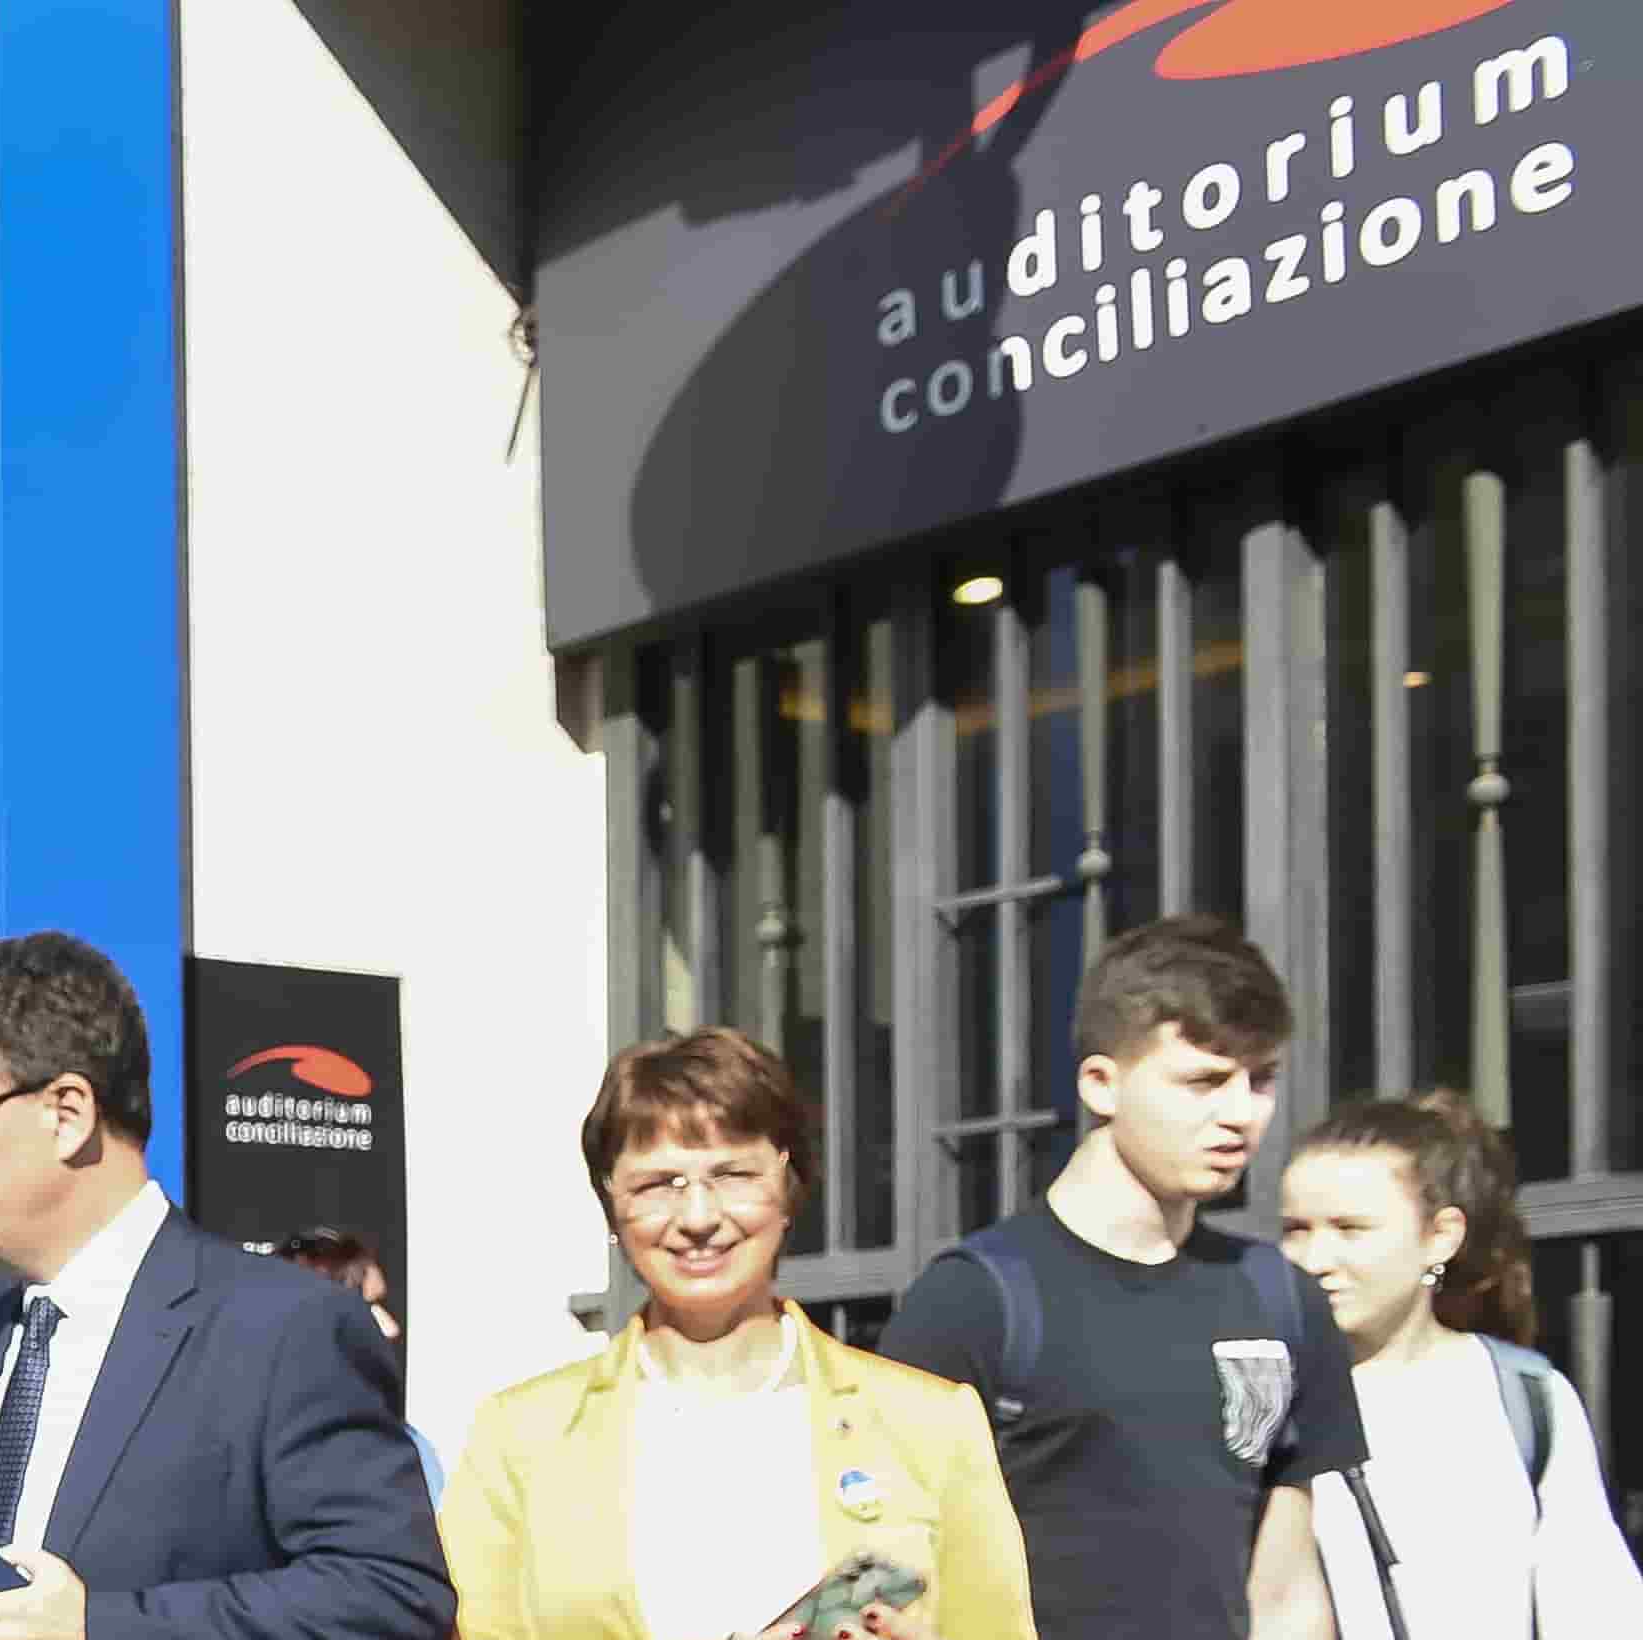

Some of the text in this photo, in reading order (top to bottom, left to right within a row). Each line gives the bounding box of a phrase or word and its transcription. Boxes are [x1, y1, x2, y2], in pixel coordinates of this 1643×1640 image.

[876, 33, 1570, 347] auditorium
[880, 141, 1576, 433] conciliazione
[225, 1090, 372, 1125] auditorium
